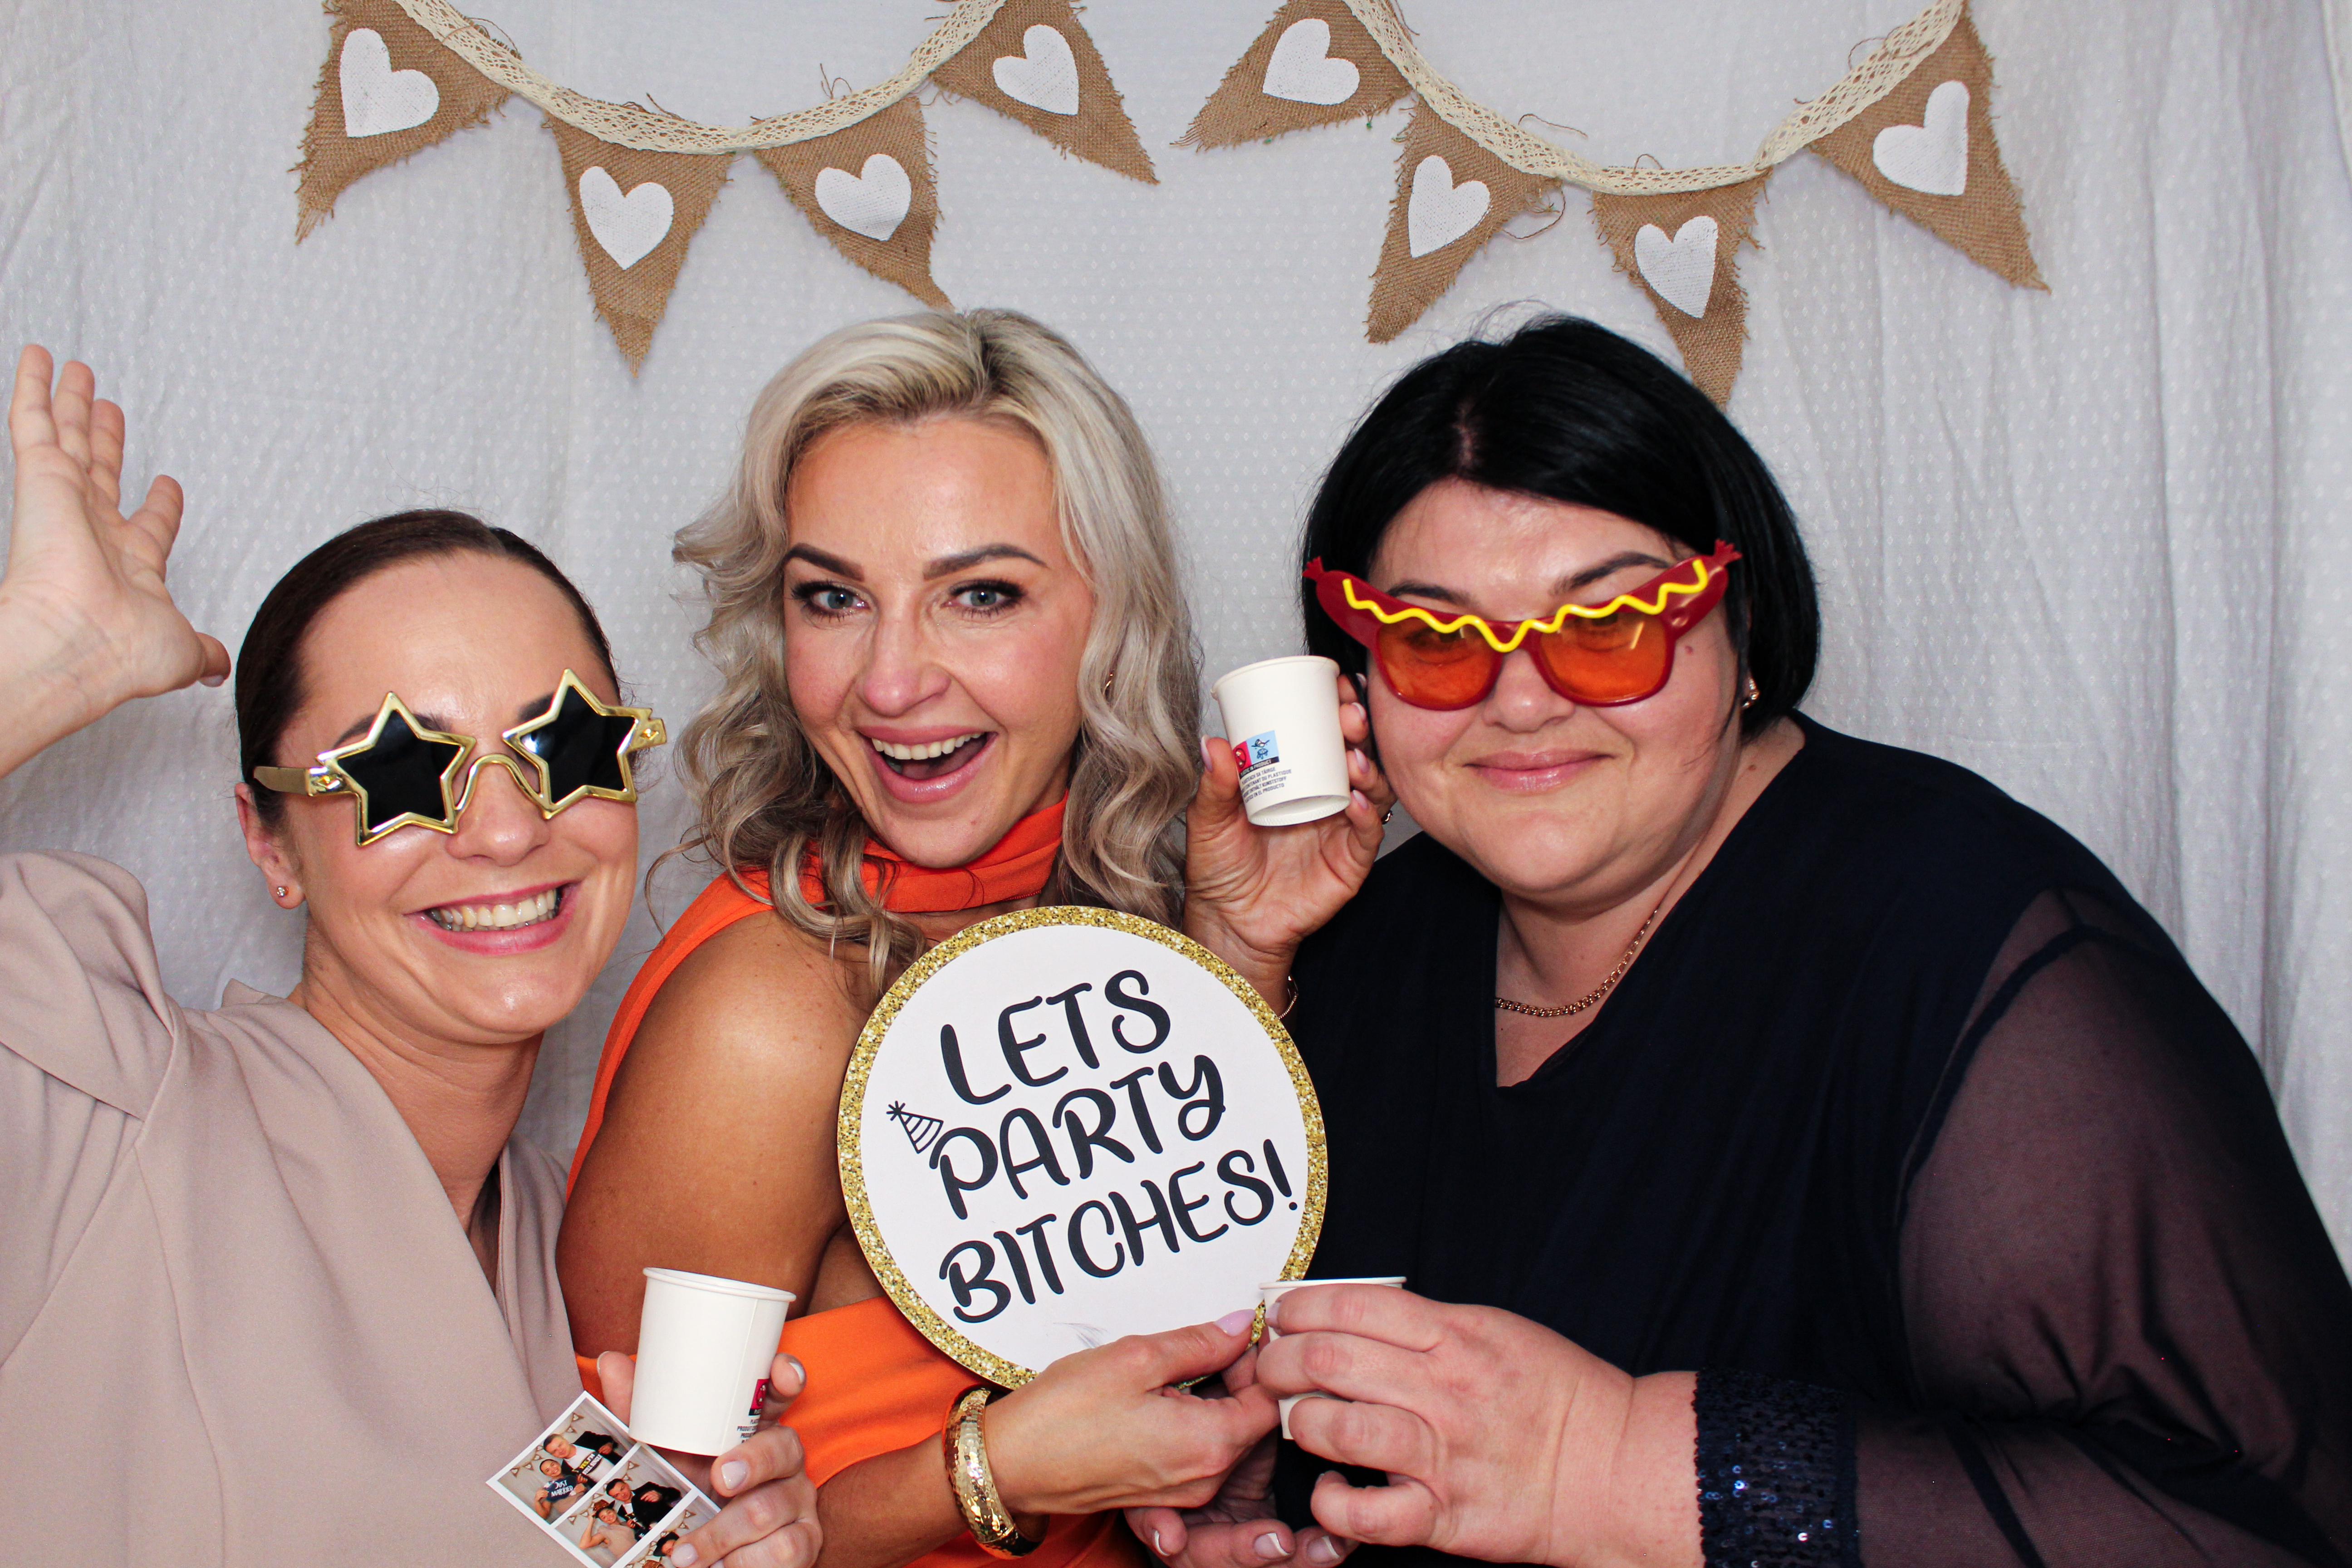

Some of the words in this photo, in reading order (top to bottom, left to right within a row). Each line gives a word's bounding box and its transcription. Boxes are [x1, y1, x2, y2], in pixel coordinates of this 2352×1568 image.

[1254, 759, 1272, 769] PRODUCT
[1268, 769, 1292, 779] PLASTIQUE
[1262, 776, 1287, 787] KUNSTSTOFF
[1263, 783, 1284, 794] PRODUCTO
[940, 970, 1171, 1104] LETS
[929, 1054, 1226, 1220] PARTY
[939, 1139, 1298, 1323] BITCHES!
[555, 1480, 567, 1489] JUST
[551, 1485, 573, 1497] MARRIED
